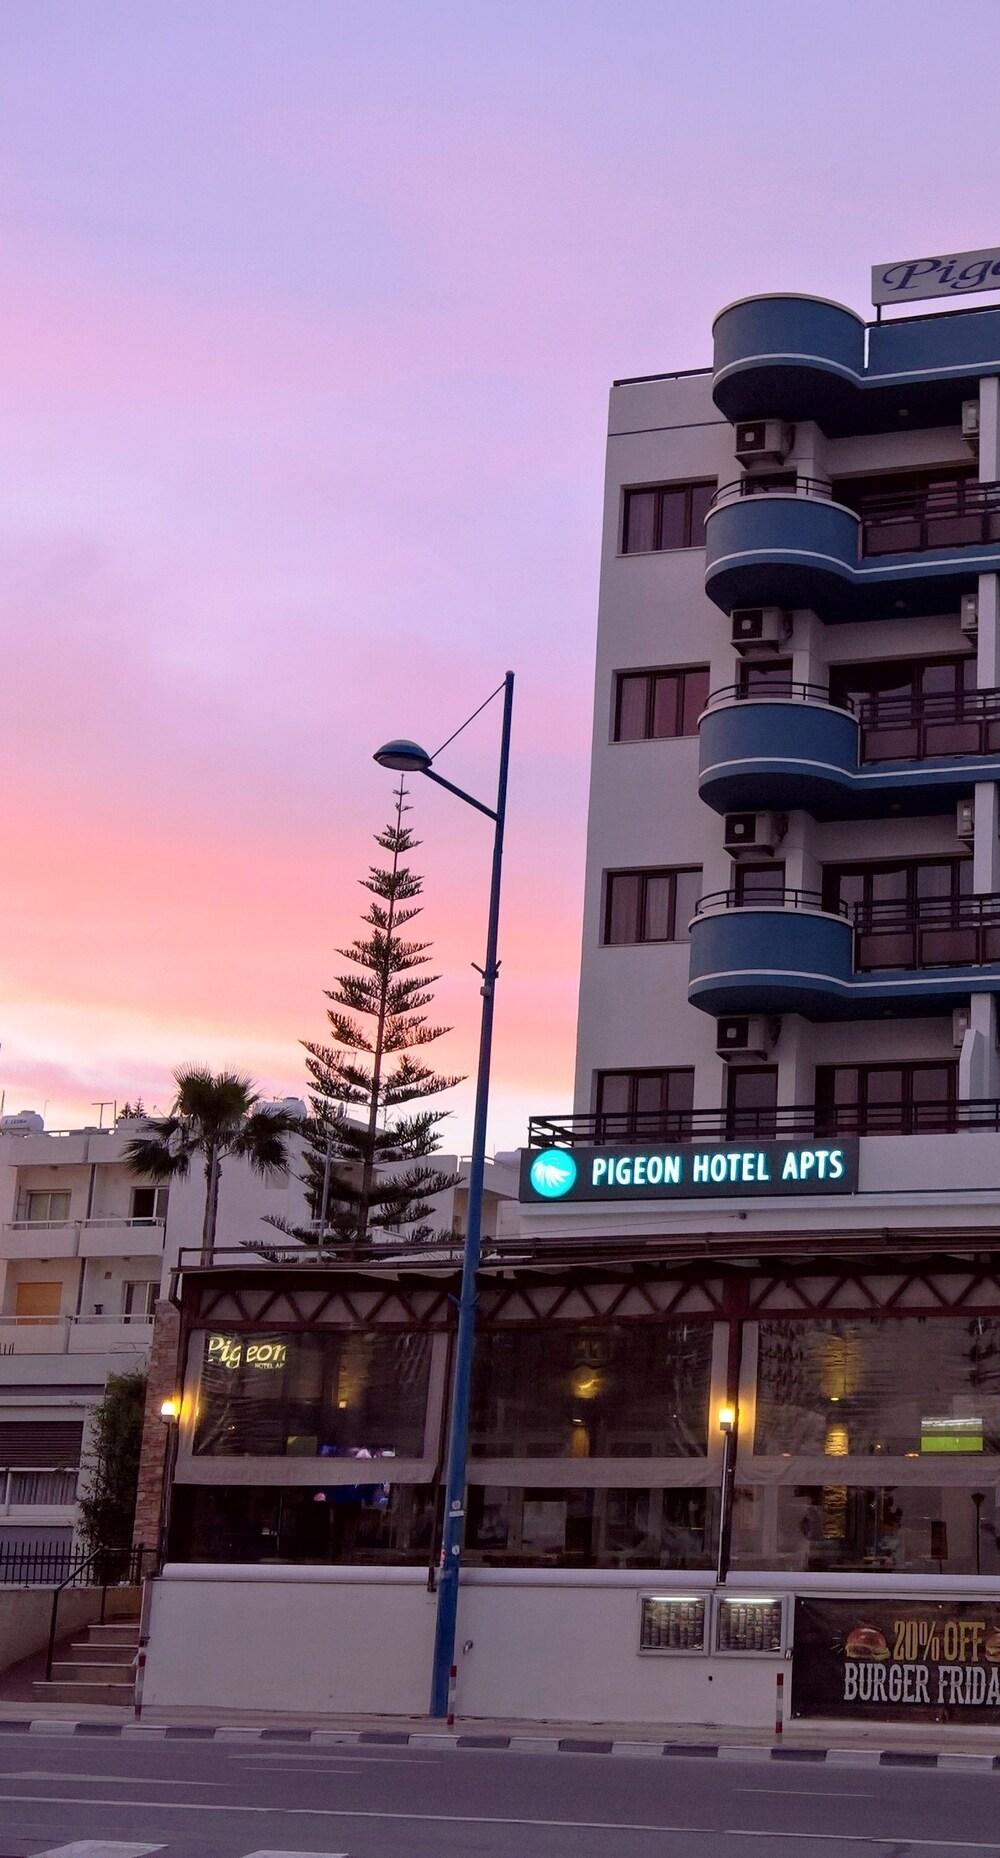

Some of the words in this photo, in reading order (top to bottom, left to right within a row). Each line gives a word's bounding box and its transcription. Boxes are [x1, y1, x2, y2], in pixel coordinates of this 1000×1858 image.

[592, 1155, 681, 1186] PIGEON
[692, 1153, 769, 1182] HOTEL
[782, 1150, 844, 1180] APTS
[208, 1336, 287, 1369] Pigeon
[893, 1620, 940, 1662] 20%
[943, 1620, 986, 1663] OFF
[843, 1662, 930, 1704] BURGER
